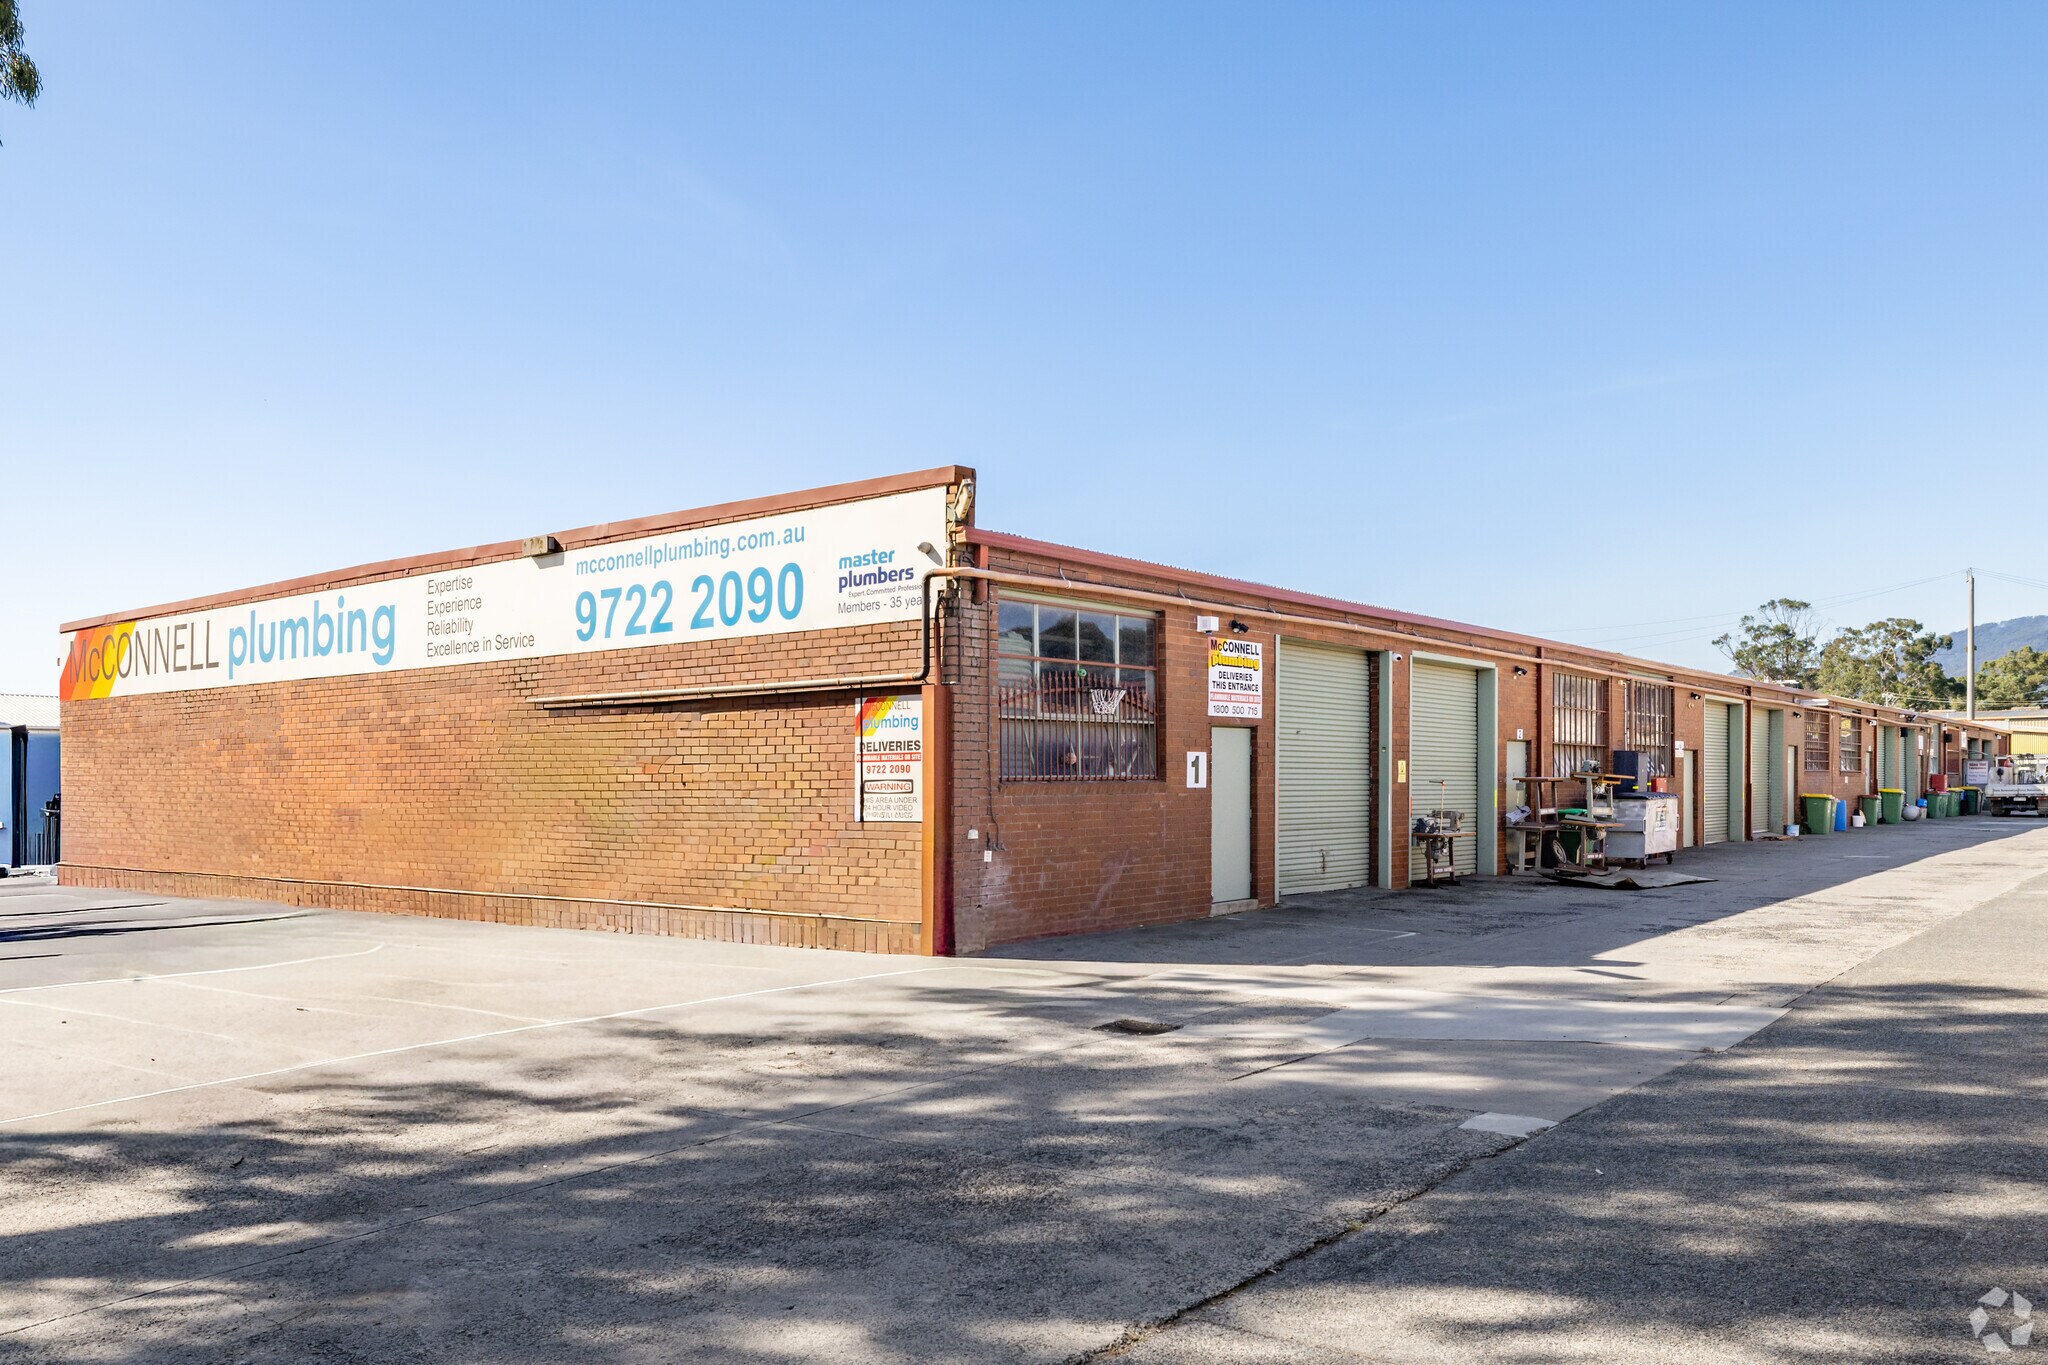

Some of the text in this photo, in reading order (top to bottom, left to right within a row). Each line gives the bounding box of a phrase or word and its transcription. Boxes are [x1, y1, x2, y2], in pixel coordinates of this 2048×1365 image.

[576, 525, 805, 575] mcconnellplumbing.com.au
[838, 548, 895, 570] master
[427, 575, 473, 596] Expertise
[838, 566, 914, 593] plumbers
[427, 597, 482, 617] Experience
[575, 562, 804, 642] 9722 2090
[838, 600, 881, 614] Members
[889, 596, 902, 609] 35
[427, 617, 474, 637] Reliability
[69, 595, 396, 684] McCONNELL plumbing
[426, 632, 535, 658] Excellence in Service
[1210, 639, 1259, 656] McCONNELL
[1211, 653, 1260, 671] plumbing
[1212, 681, 1259, 692] THIS ENTRANCE
[1218, 671, 1253, 682] DELIVERIES
[1213, 705, 1258, 716] 1800 500 715
[862, 714, 919, 733] plumbing
[866, 764, 911, 774] 9722 2090
[1191, 755, 1200, 784] 1
[866, 783, 911, 791] WARNING
